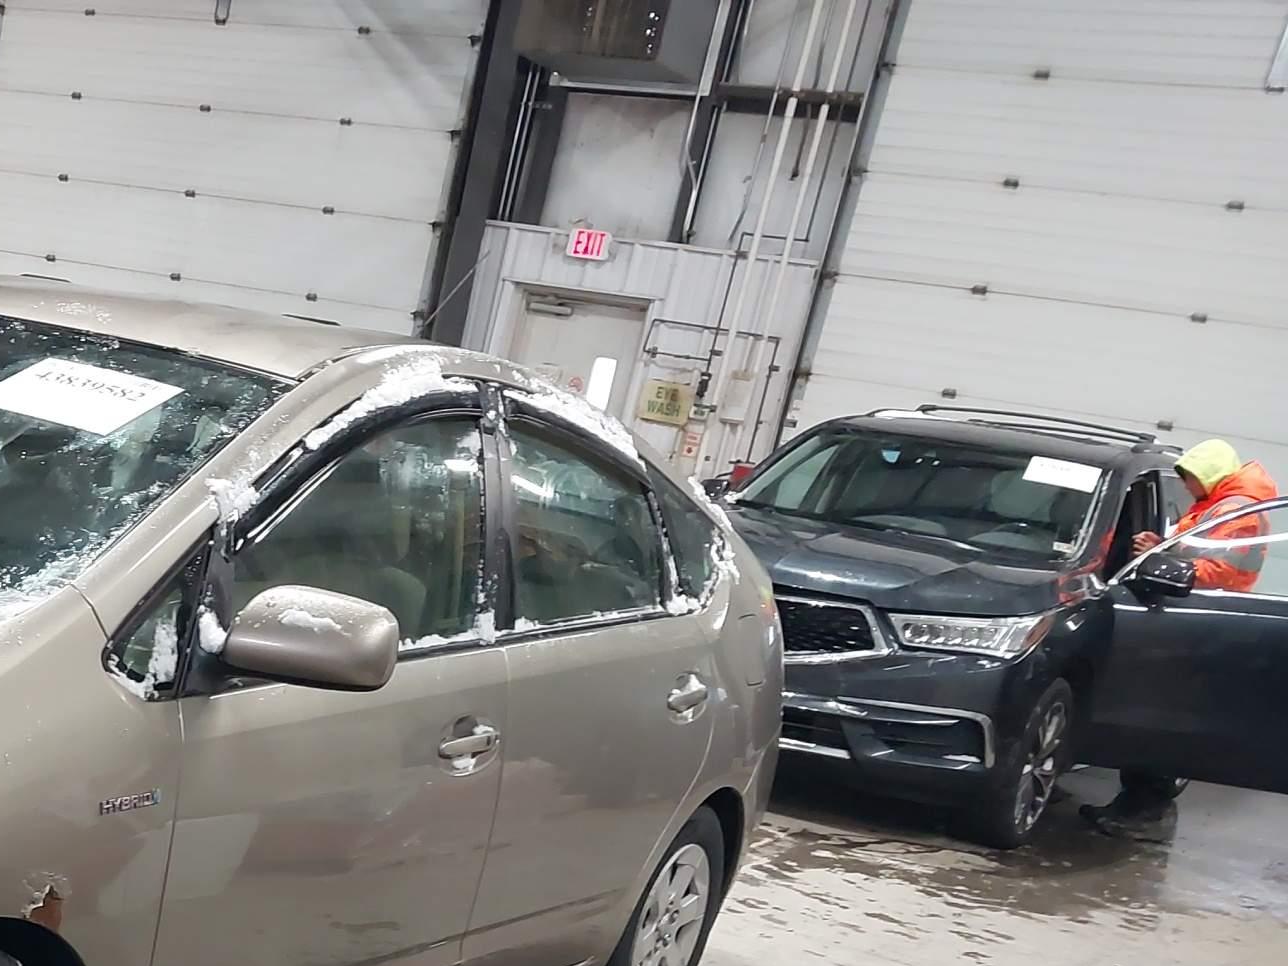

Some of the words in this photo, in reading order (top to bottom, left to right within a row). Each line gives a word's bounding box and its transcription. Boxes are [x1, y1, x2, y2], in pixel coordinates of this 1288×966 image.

[573, 230, 607, 257] EXIT
[34, 370, 147, 403] 43839582
[655, 386, 680, 402] EYE
[647, 400, 681, 417] WASH
[99, 792, 153, 816] HYBRID
